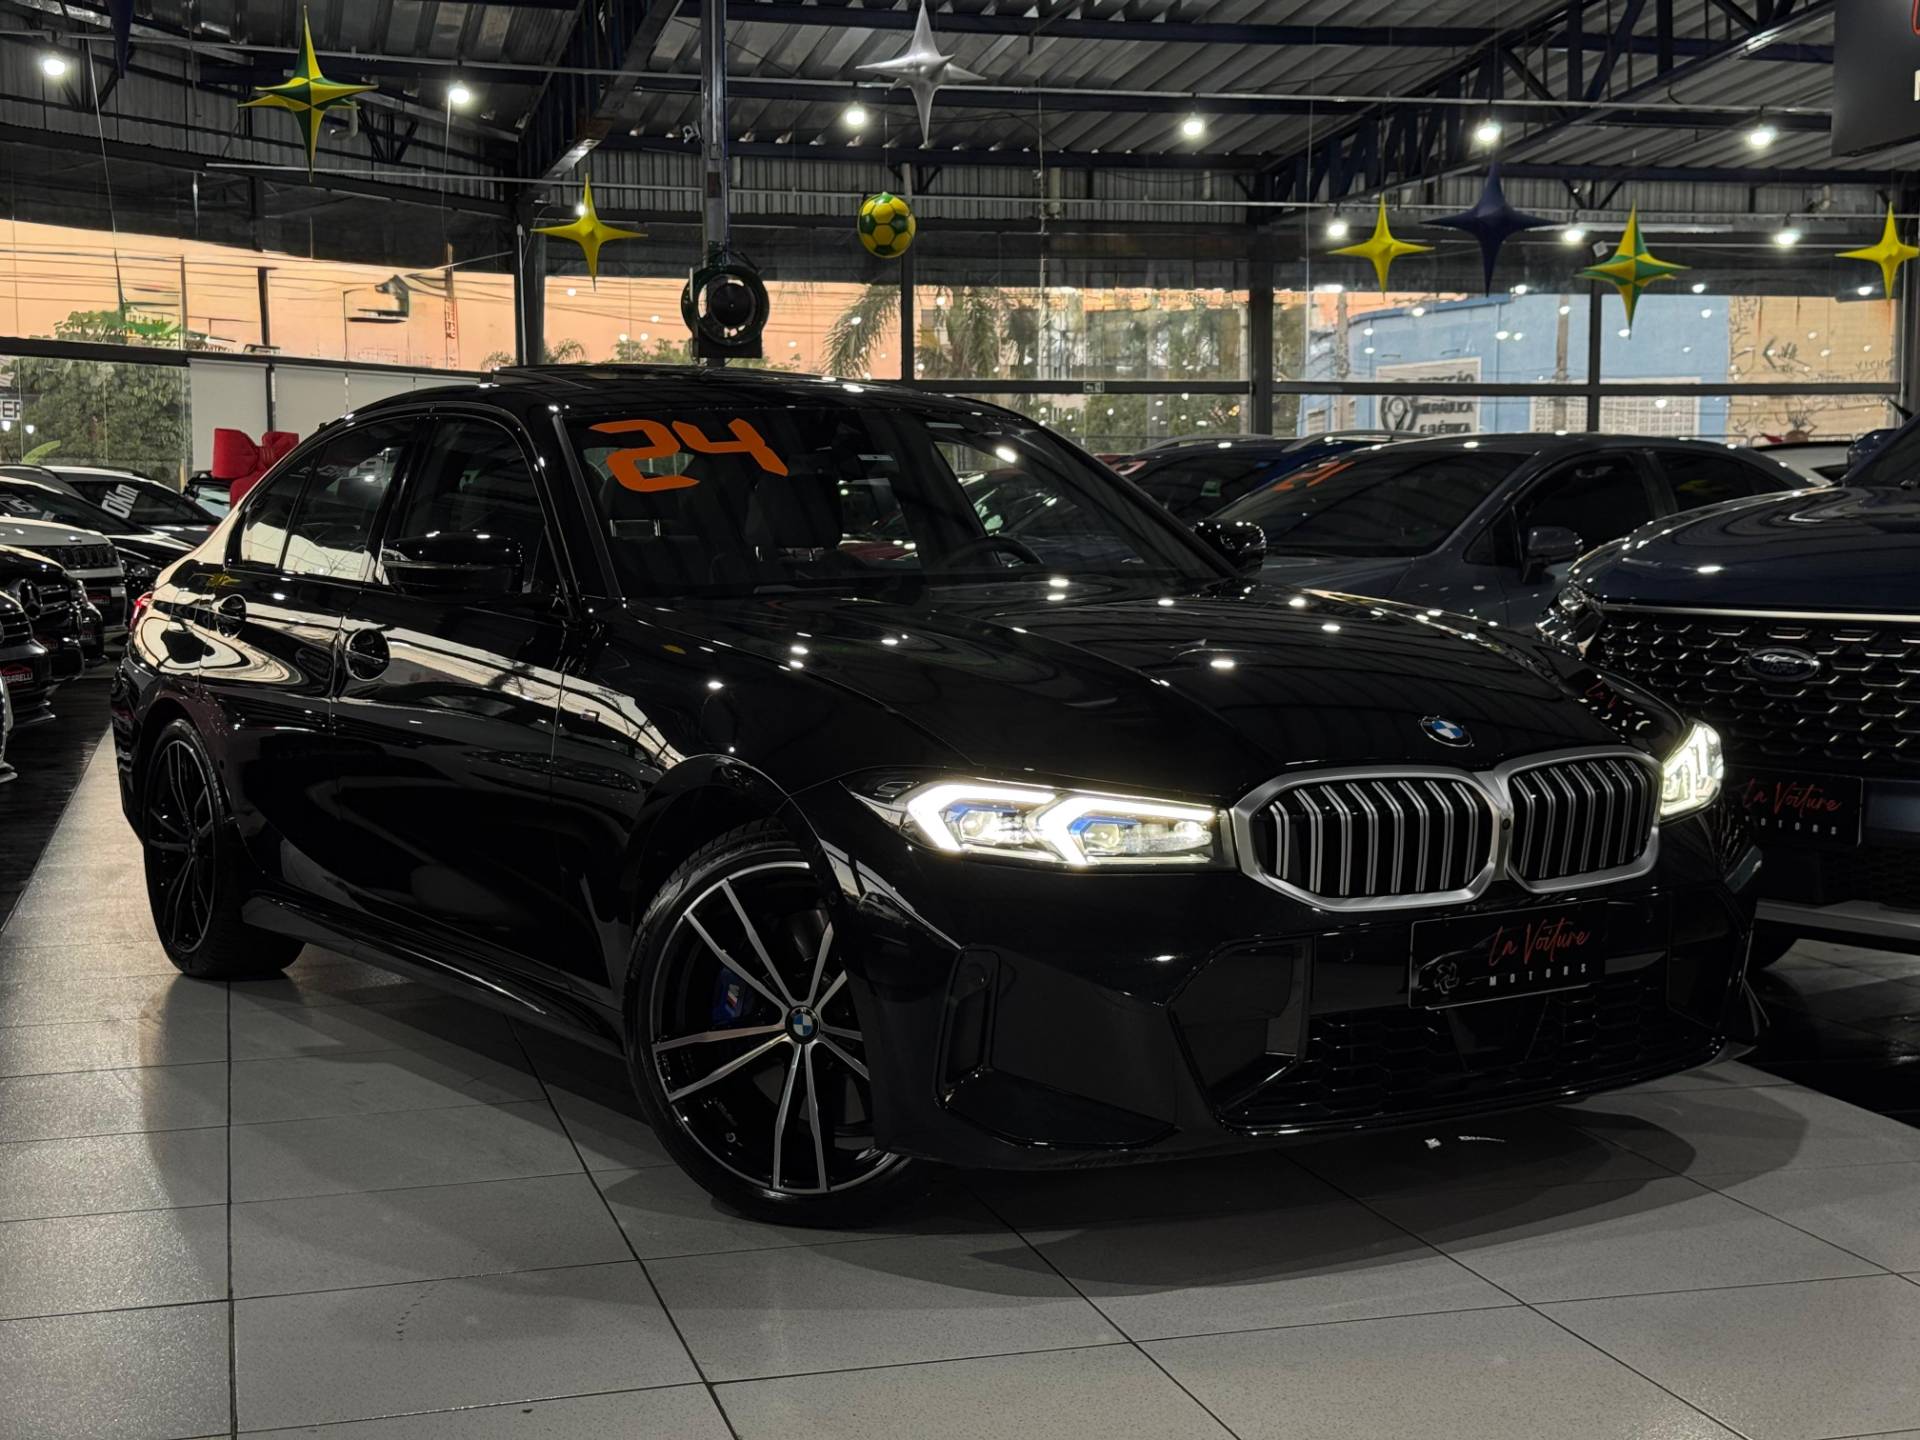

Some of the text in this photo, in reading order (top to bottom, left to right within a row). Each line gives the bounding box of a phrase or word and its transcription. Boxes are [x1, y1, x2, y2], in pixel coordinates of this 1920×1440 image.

[588, 418, 789, 492] 24
[1773, 780, 1841, 818] Voiture
[1488, 916, 1592, 966] La Voiture
[1489, 959, 1587, 986] MOTORS
